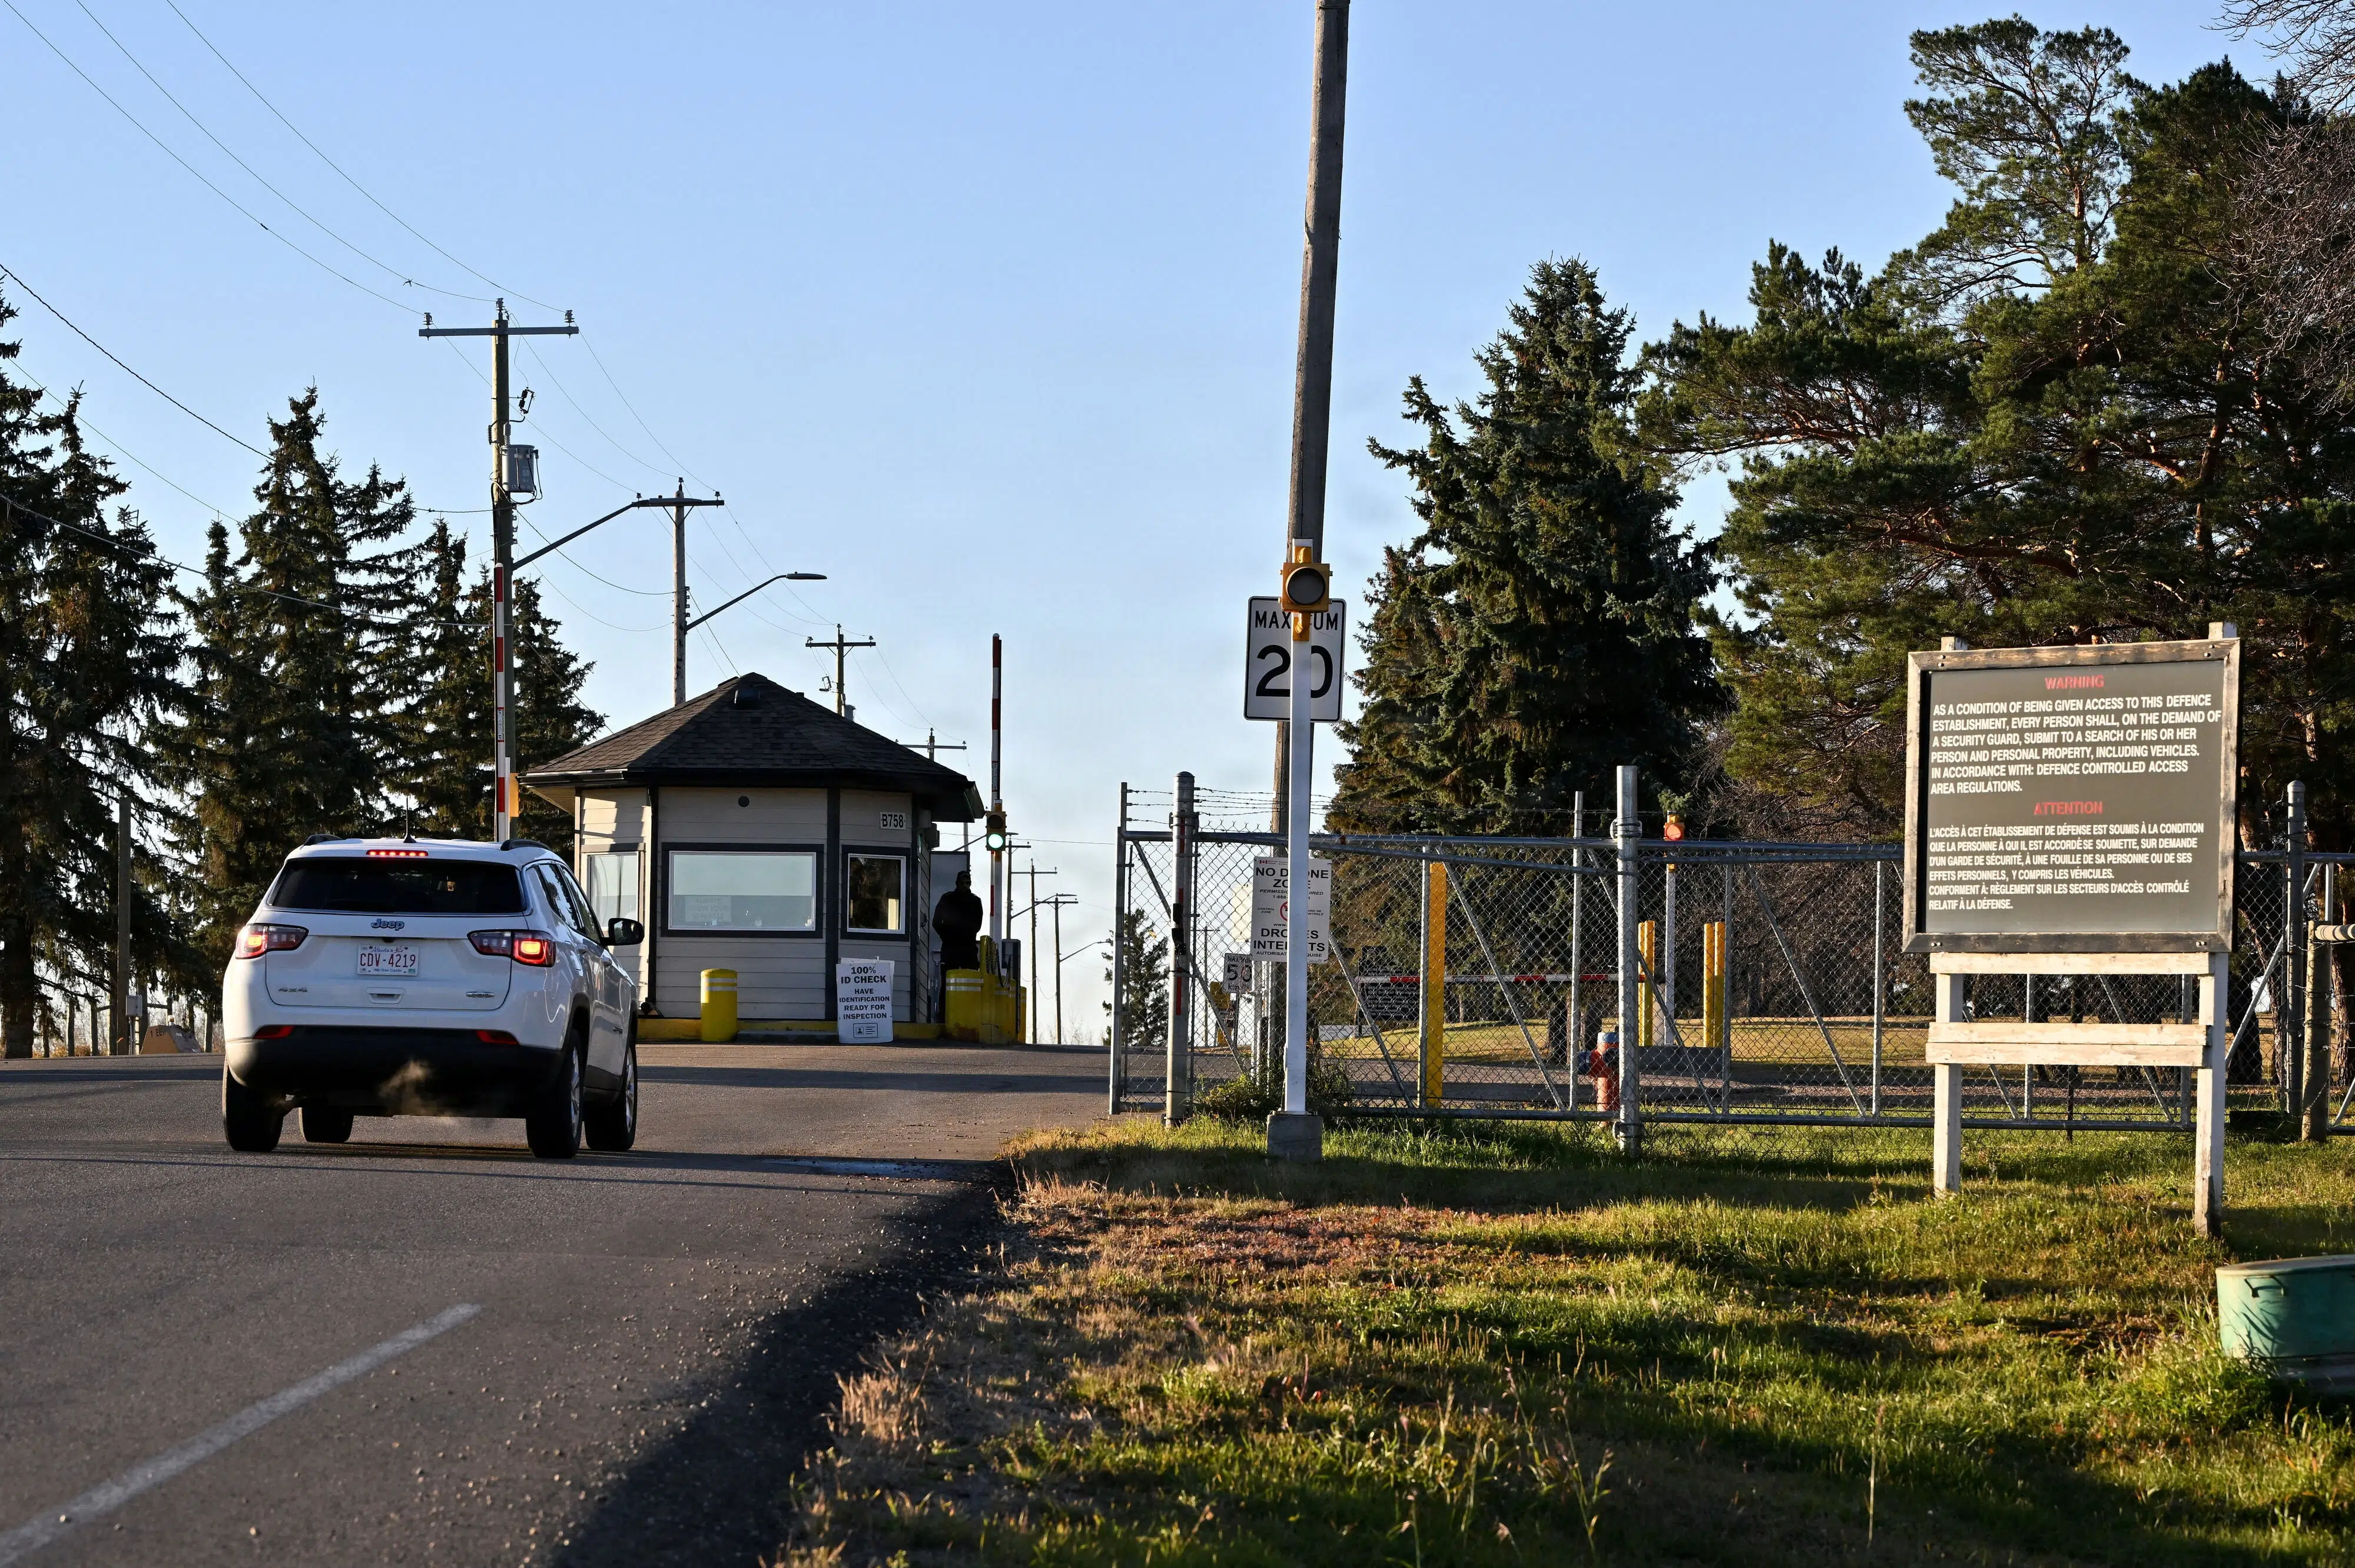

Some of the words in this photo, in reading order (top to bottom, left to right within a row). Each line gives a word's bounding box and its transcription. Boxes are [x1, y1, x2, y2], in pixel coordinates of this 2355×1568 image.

[1255, 610, 1338, 630] MAXUM
[1256, 645, 1333, 699] 20
[2045, 675, 2104, 689] WARNING
[1933, 704, 1946, 716] AS
[1947, 704, 1955, 715] A
[1956, 702, 2007, 715] CONDITION
[2009, 702, 2022, 713] OF
[2024, 700, 2053, 712] BEING
[2055, 699, 2083, 711] GIVEN
[2085, 697, 2124, 710] ACCESS
[2125, 697, 2139, 709] TO
[2141, 696, 2163, 708] THIS
[2166, 694, 2211, 707] DEFENCE
[1933, 718, 2009, 731] ESTABLISHMENT,
[2011, 717, 2041, 728] EVERY
[2043, 715, 2084, 727] PERSON
[2085, 714, 2120, 727] SHALL,
[2122, 713, 2137, 725] ON
[2139, 713, 2160, 724] THE
[2161, 711, 2205, 723] DEMAND
[2207, 710, 2222, 722] OF
[1933, 736, 1939, 747] A
[1941, 735, 1985, 747] SECURITY
[1986, 733, 2022, 746] GUARD,
[2024, 732, 2059, 744] SUBMIT
[2061, 731, 2074, 742] TO
[2075, 731, 2082, 742] A
[2085, 730, 2124, 742] SEARCH
[2125, 730, 2140, 741] OF
[2141, 729, 2158, 740] HIS
[2160, 729, 2174, 740] OR
[2176, 728, 2196, 739] HER
[1931, 751, 1968, 763] PERSON
[1969, 750, 1989, 762] AND
[1991, 749, 2040, 761] PERSONAL
[2042, 747, 2094, 760] PROPERTY,
[2096, 745, 2148, 758] INCLUDING
[2150, 745, 2199, 756] VEHICLES.
[1932, 768, 1941, 779] IN
[1942, 765, 2006, 778] ACCORDANCE
[2008, 764, 2034, 776] WITH:
[2036, 763, 2080, 775] DEFENCE
[2082, 762, 2145, 774] CONTROLLED
[2148, 760, 2188, 772] ACCESS
[1931, 783, 1955, 794] AREA
[1956, 780, 2022, 793] REGULATIONS.
[2034, 801, 2102, 815] ATTENTION
[883, 814, 904, 828] B758
[1930, 825, 1960, 838] L'ACCÈS
[1961, 825, 1966, 837] À
[1968, 827, 1982, 837] CET
[1983, 824, 2044, 836] ÉTABLISSEMENT
[2045, 826, 2055, 835] DE
[2057, 822, 2092, 835] DÉFENSE
[2092, 825, 2108, 835] EST
[2109, 824, 2140, 834] SOUMIS
[2140, 821, 2147, 833] À
[2148, 824, 2158, 833] LA
[2160, 823, 2204, 833] CONDITION
[1930, 842, 1945, 852] QUE
[1946, 842, 1956, 851] LA
[1957, 841, 1998, 851] PERSONNE
[1998, 838, 2004, 851] À
[2005, 841, 2019, 851] QUI
[2020, 841, 2028, 850] IL
[2028, 841, 2043, 850] EST
[2095, 839, 2139, 850] SOUMETTE,
[2141, 839, 2157, 848] SUR
[2158, 838, 2197, 848] DEMANDE
[1929, 856, 1946, 866] D'UN
[1947, 856, 1973, 866] GARDE
[1974, 856, 1985, 865] DE
[1985, 852, 2024, 866] SÉCURITÉ,
[2025, 852, 2031, 865] À
[2032, 855, 2048, 865] UNE
[2050, 855, 2081, 864] FOUILLE
[2083, 854, 2094, 864] DE
[2095, 854, 2105, 864] SA
[2107, 853, 2150, 863] PERSONNE
[2150, 853, 2162, 863] OU
[2164, 853, 2175, 863] DE
[2177, 853, 2192, 863] SES
[1256, 868, 1275, 876] NO
[1281, 869, 1328, 878] DNE
[1929, 871, 1956, 881] EFFETS
[1957, 870, 2009, 882] PERSONNELS,
[2012, 871, 2017, 879] Y
[2018, 869, 2053, 879] COMPRIS
[2054, 869, 2069, 879] LES
[2070, 866, 2114, 879] VÉHICULES.
[1929, 885, 1980, 895] CONFORMENT
[1981, 882, 1989, 894] À:
[1990, 881, 2035, 894] RÈGLEMENT
[2036, 884, 2052, 894] SUR
[2053, 884, 2068, 893] LES
[2069, 883, 2109, 893] SECTEURS
[2111, 881, 2144, 893] D'ACCÈS
[2146, 880, 2189, 893] CONTRÔLÉ
[1929, 900, 1958, 910] RELATIF
[1959, 897, 1965, 909] À
[1966, 900, 1976, 909] LA
[1977, 897, 2013, 909] DÉFENSE.
[371, 919, 404, 931] Jeep
[360, 953, 416, 968] CDV-4219
[854, 975, 887, 984] CHECK
